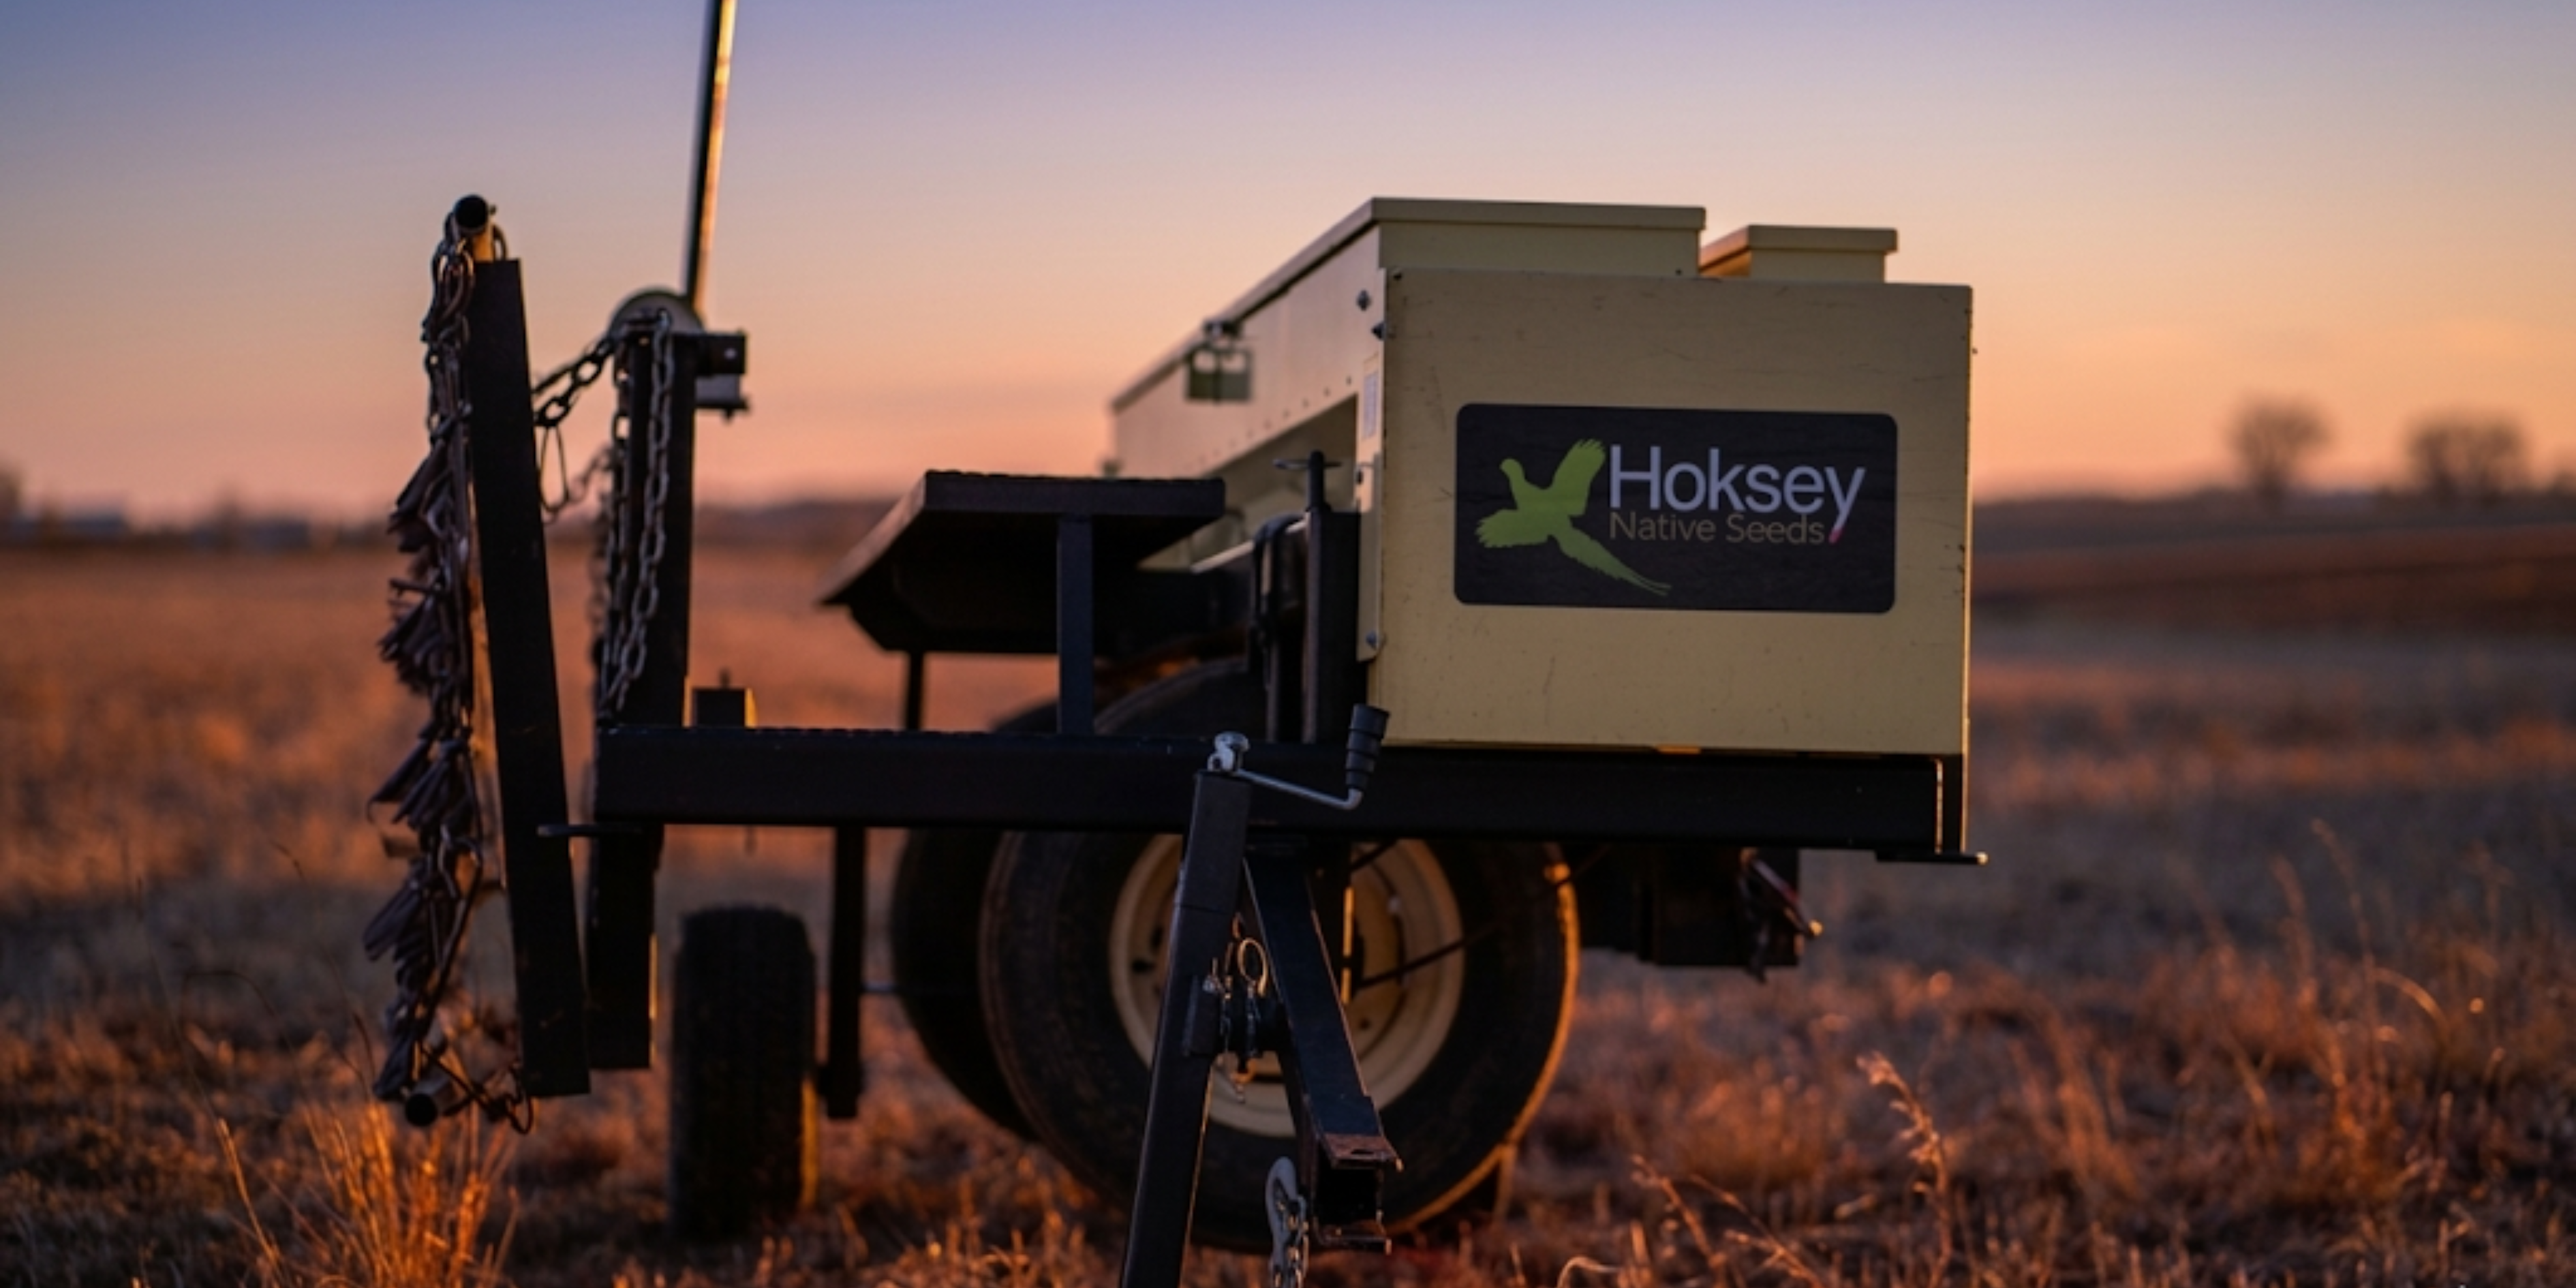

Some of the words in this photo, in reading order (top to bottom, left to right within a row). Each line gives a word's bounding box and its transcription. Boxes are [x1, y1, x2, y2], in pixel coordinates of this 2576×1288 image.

[1610, 444, 1866, 543] Hoksey
[1610, 511, 1716, 541] Native
[1726, 513, 1825, 544] Seeds
